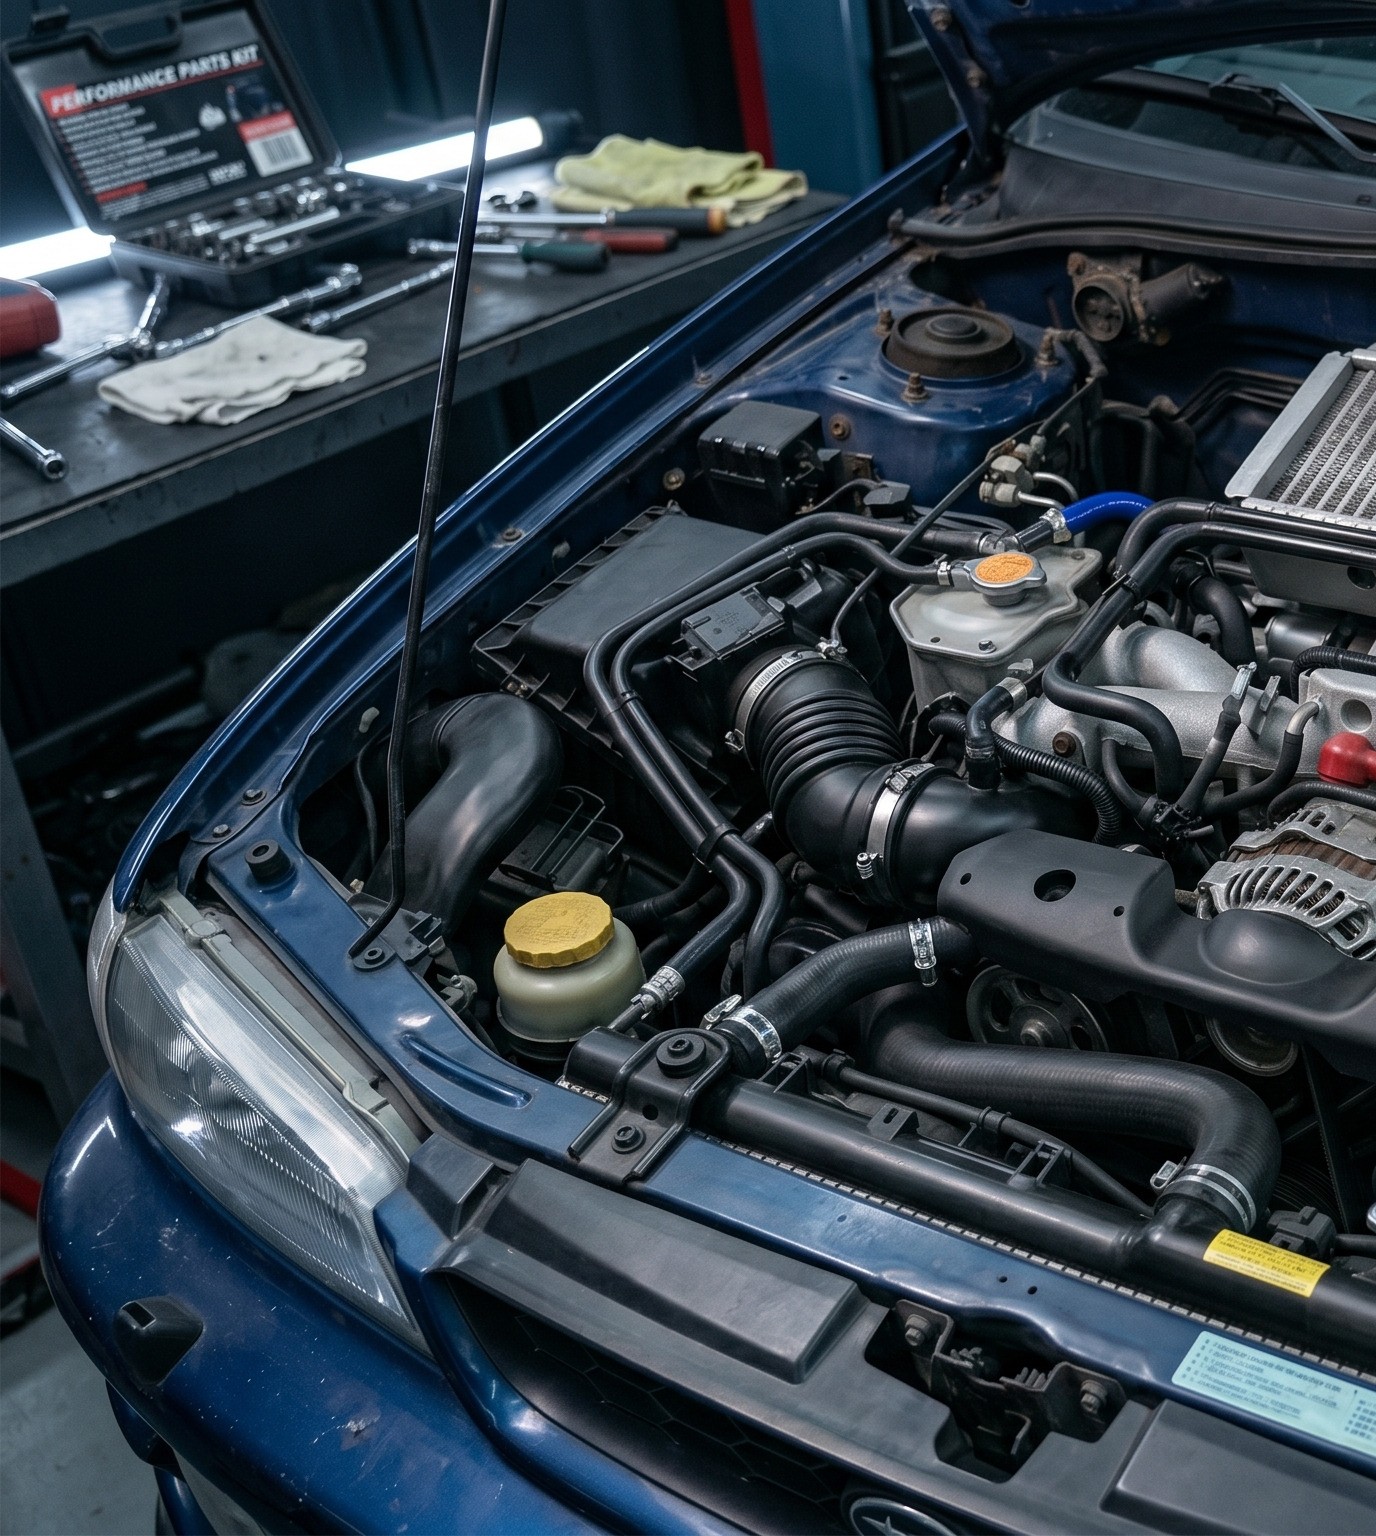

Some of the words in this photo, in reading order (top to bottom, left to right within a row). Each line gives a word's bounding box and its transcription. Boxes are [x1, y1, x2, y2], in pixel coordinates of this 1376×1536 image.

[51, 65, 177, 113] PERFORMANCE
[177, 51, 231, 80] PARTS
[231, 43, 259, 65] KIT
